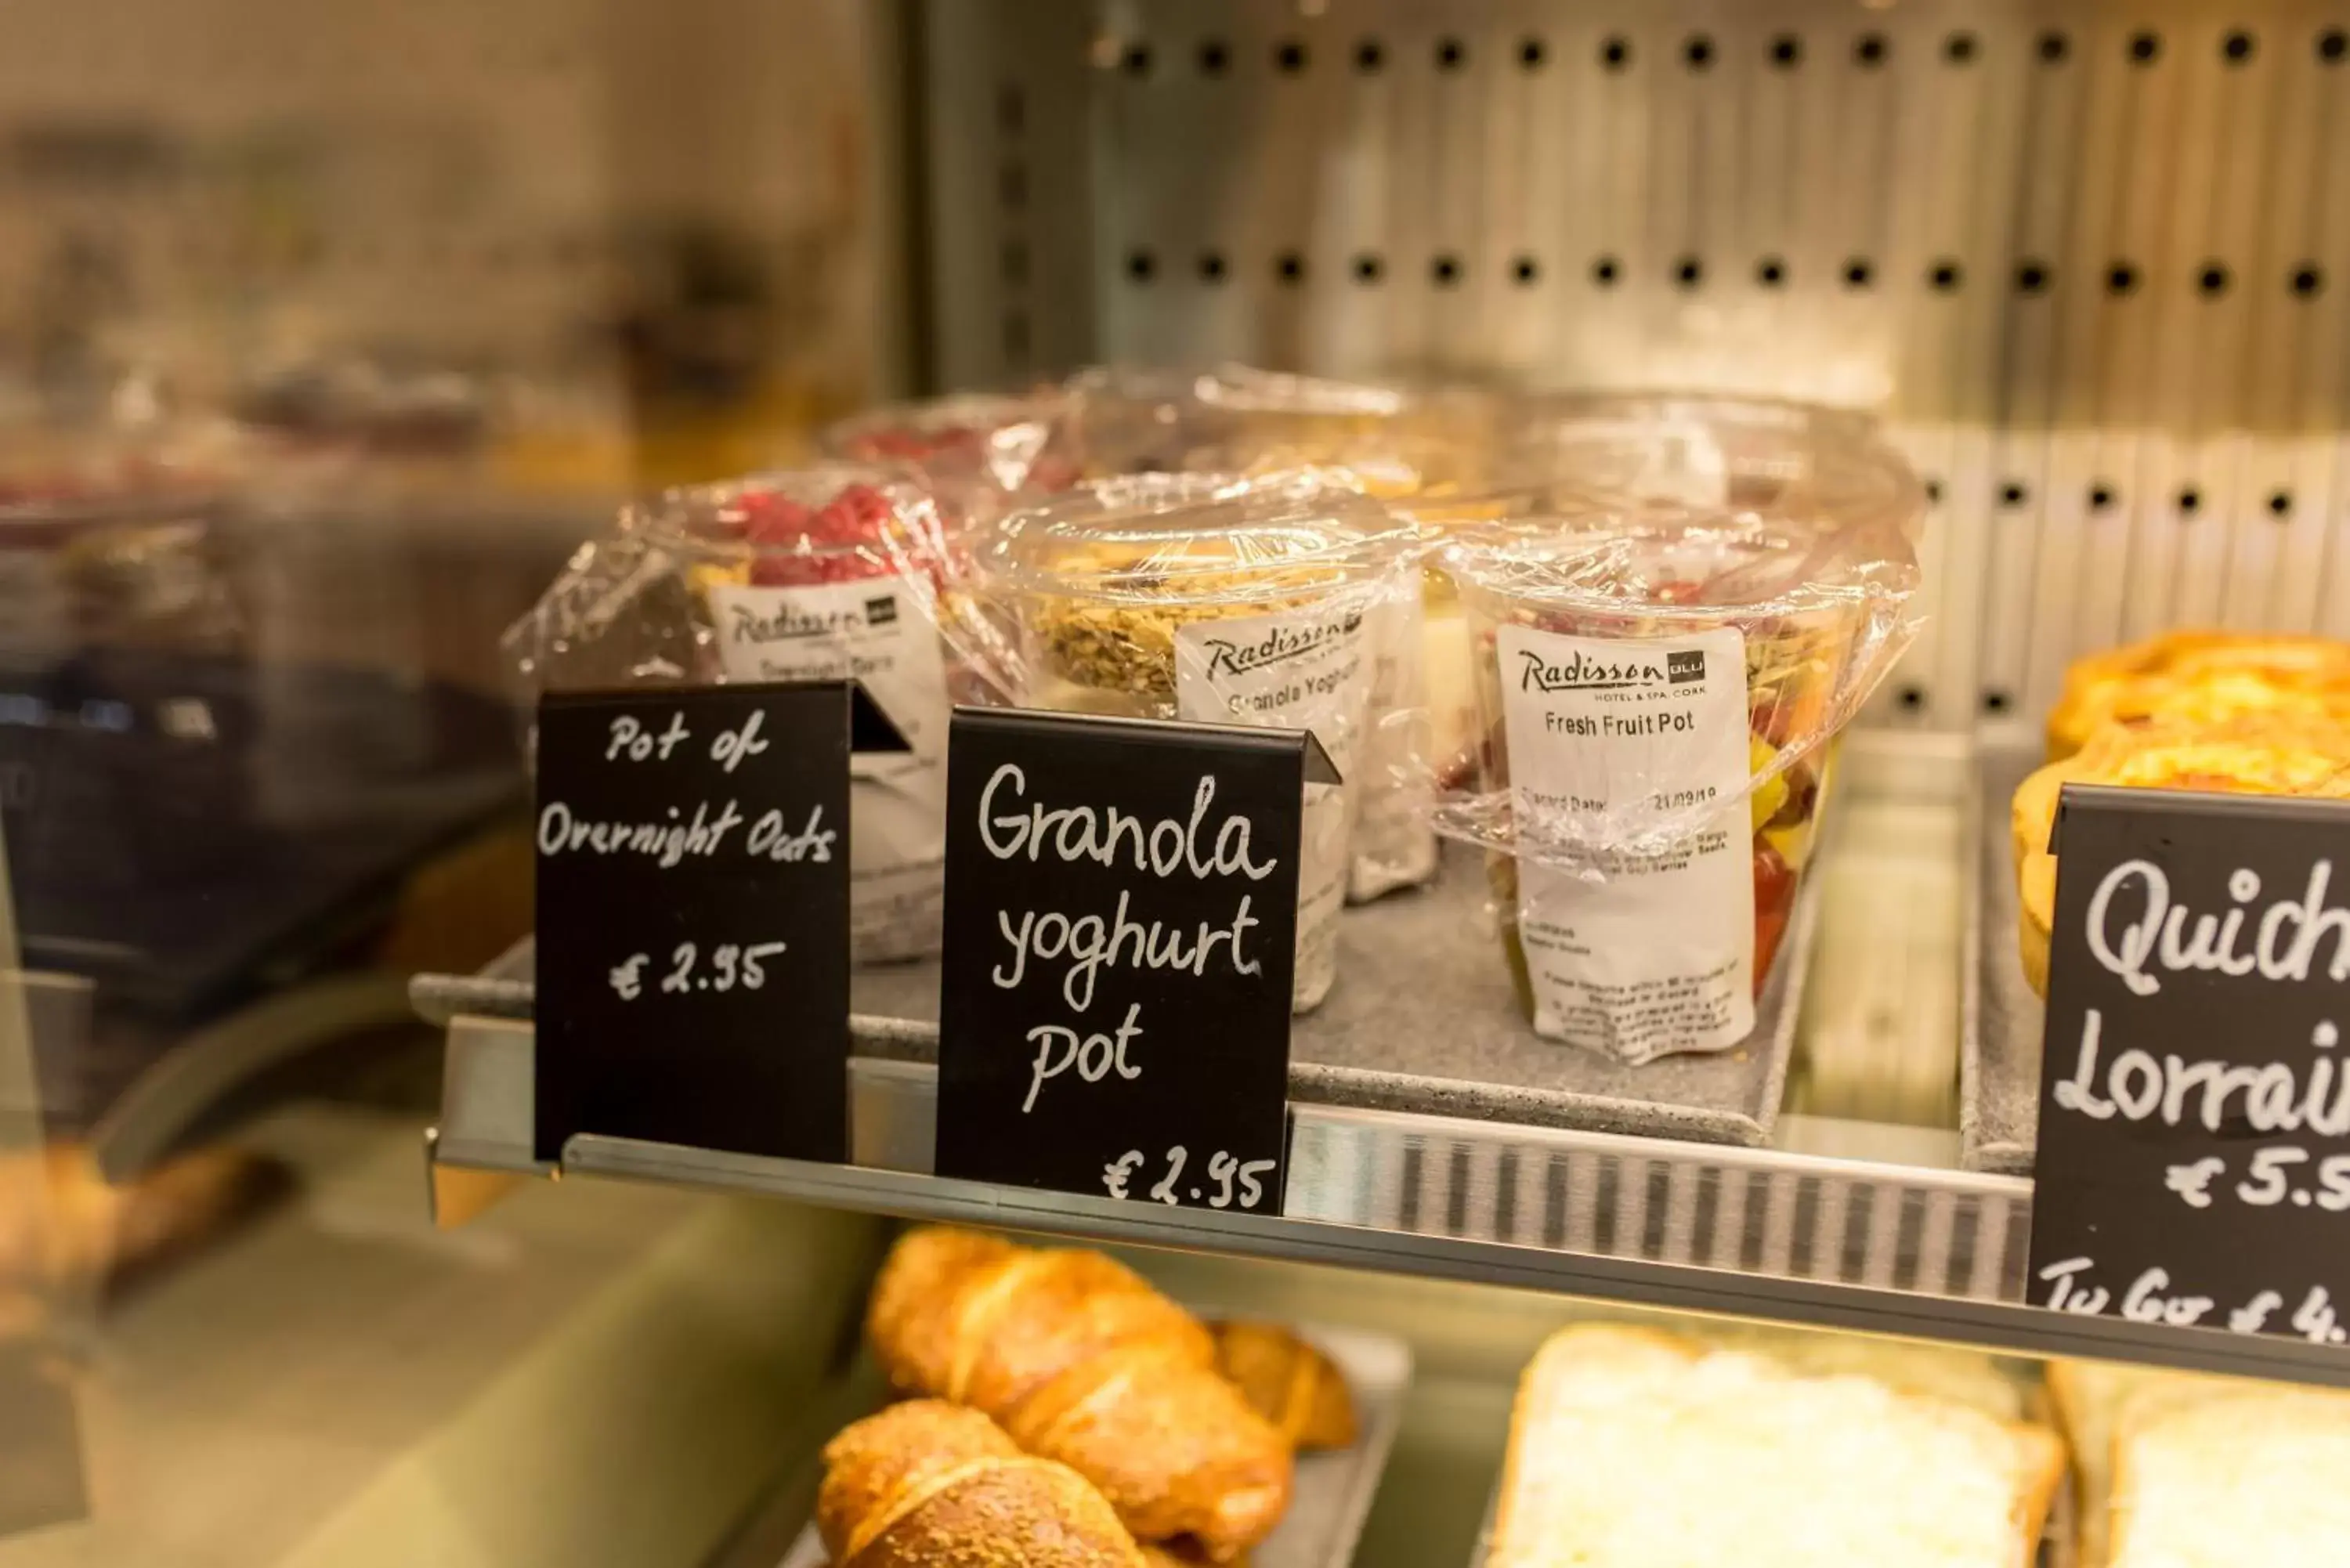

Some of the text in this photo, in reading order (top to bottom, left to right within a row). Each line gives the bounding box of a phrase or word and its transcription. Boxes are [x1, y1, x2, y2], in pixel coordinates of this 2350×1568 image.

[1204, 623, 1342, 681] Radisson
[1518, 649, 1665, 692] Radisson
[1227, 684, 1301, 715] Ganola
[1546, 710, 1695, 736] Fresh Fruit Pot
[1594, 692, 1633, 703] HOTEL
[1636, 692, 1644, 702] &
[604, 709, 769, 772] Pot of
[538, 799, 837, 869] Overnight Oats
[978, 763, 1278, 880] Granola
[660, 941, 787, 992] 2.95
[992, 889, 1260, 1012] yoghurt
[2052, 1008, 2350, 1137] Lorrai
[1102, 1144, 1277, 1209] € 2.95
[2164, 1155, 2227, 1209] €
[2038, 1256, 2110, 1315] To
[2121, 1266, 2215, 1326] Go
